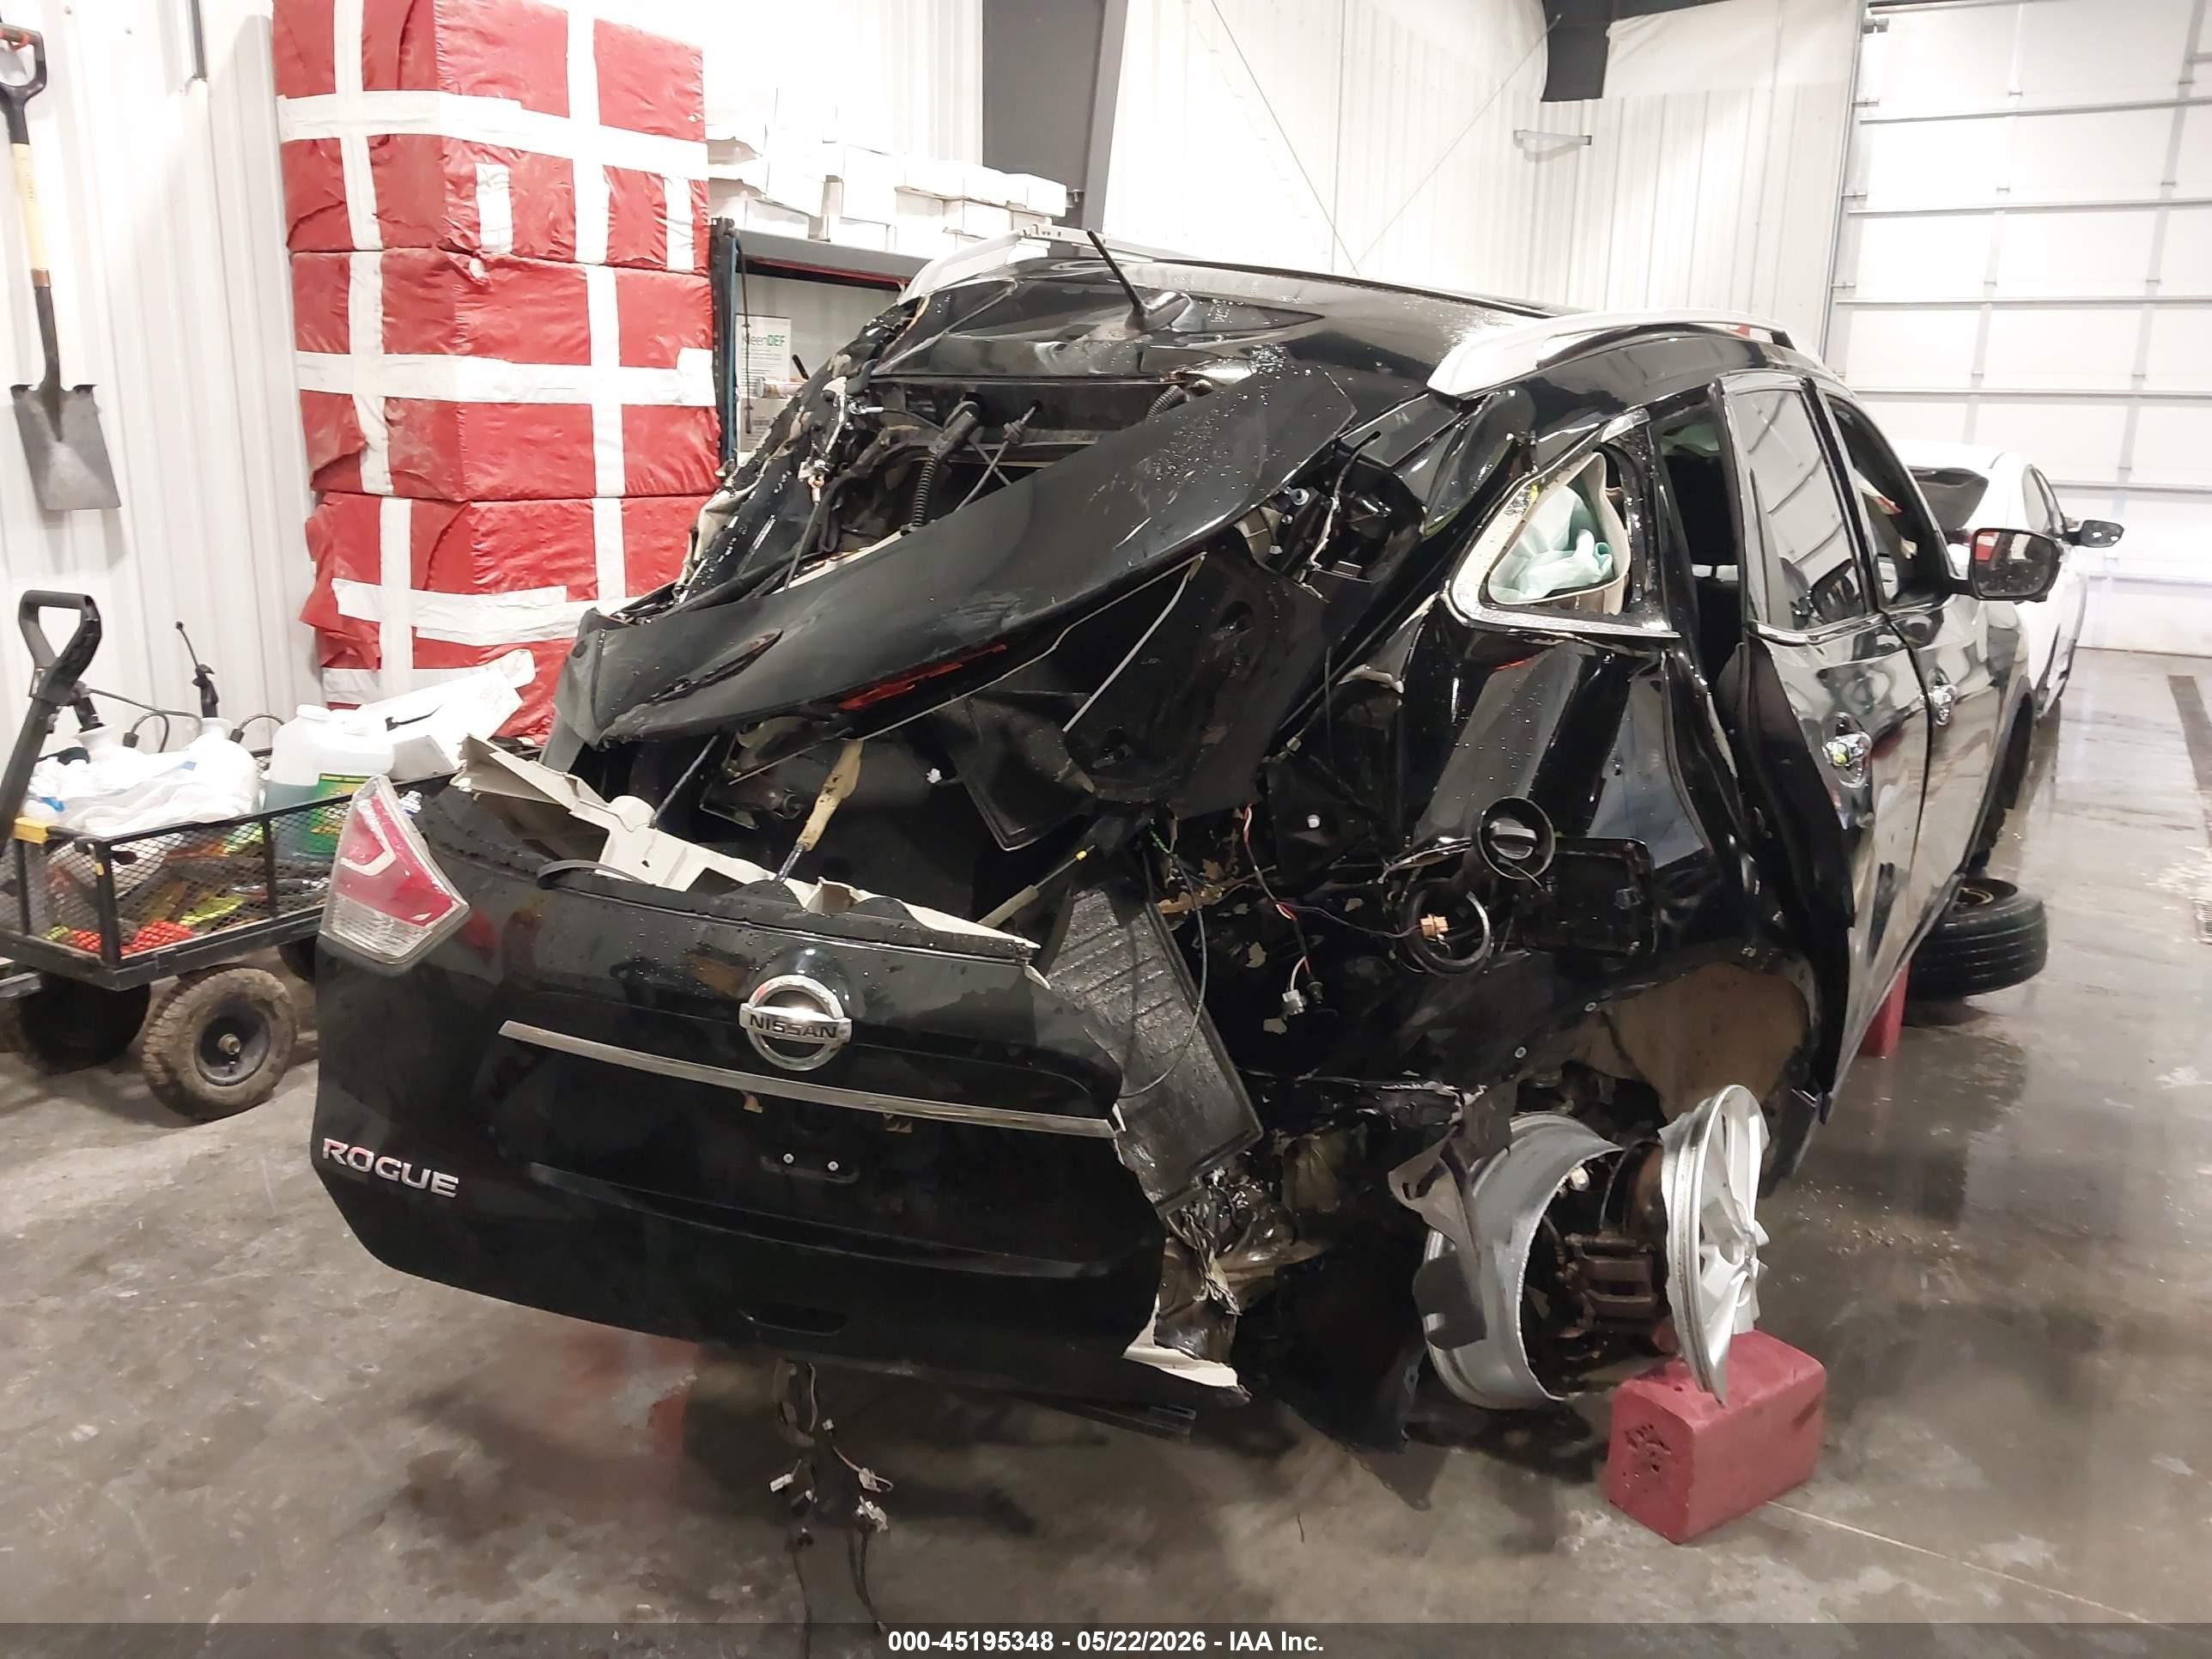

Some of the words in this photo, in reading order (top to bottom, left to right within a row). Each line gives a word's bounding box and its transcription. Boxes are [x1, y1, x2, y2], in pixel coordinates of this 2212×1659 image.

[741, 332, 786, 347] KeenDEF
[750, 1014, 837, 1039] NISSAN
[323, 1138, 459, 1199] ROGUE
